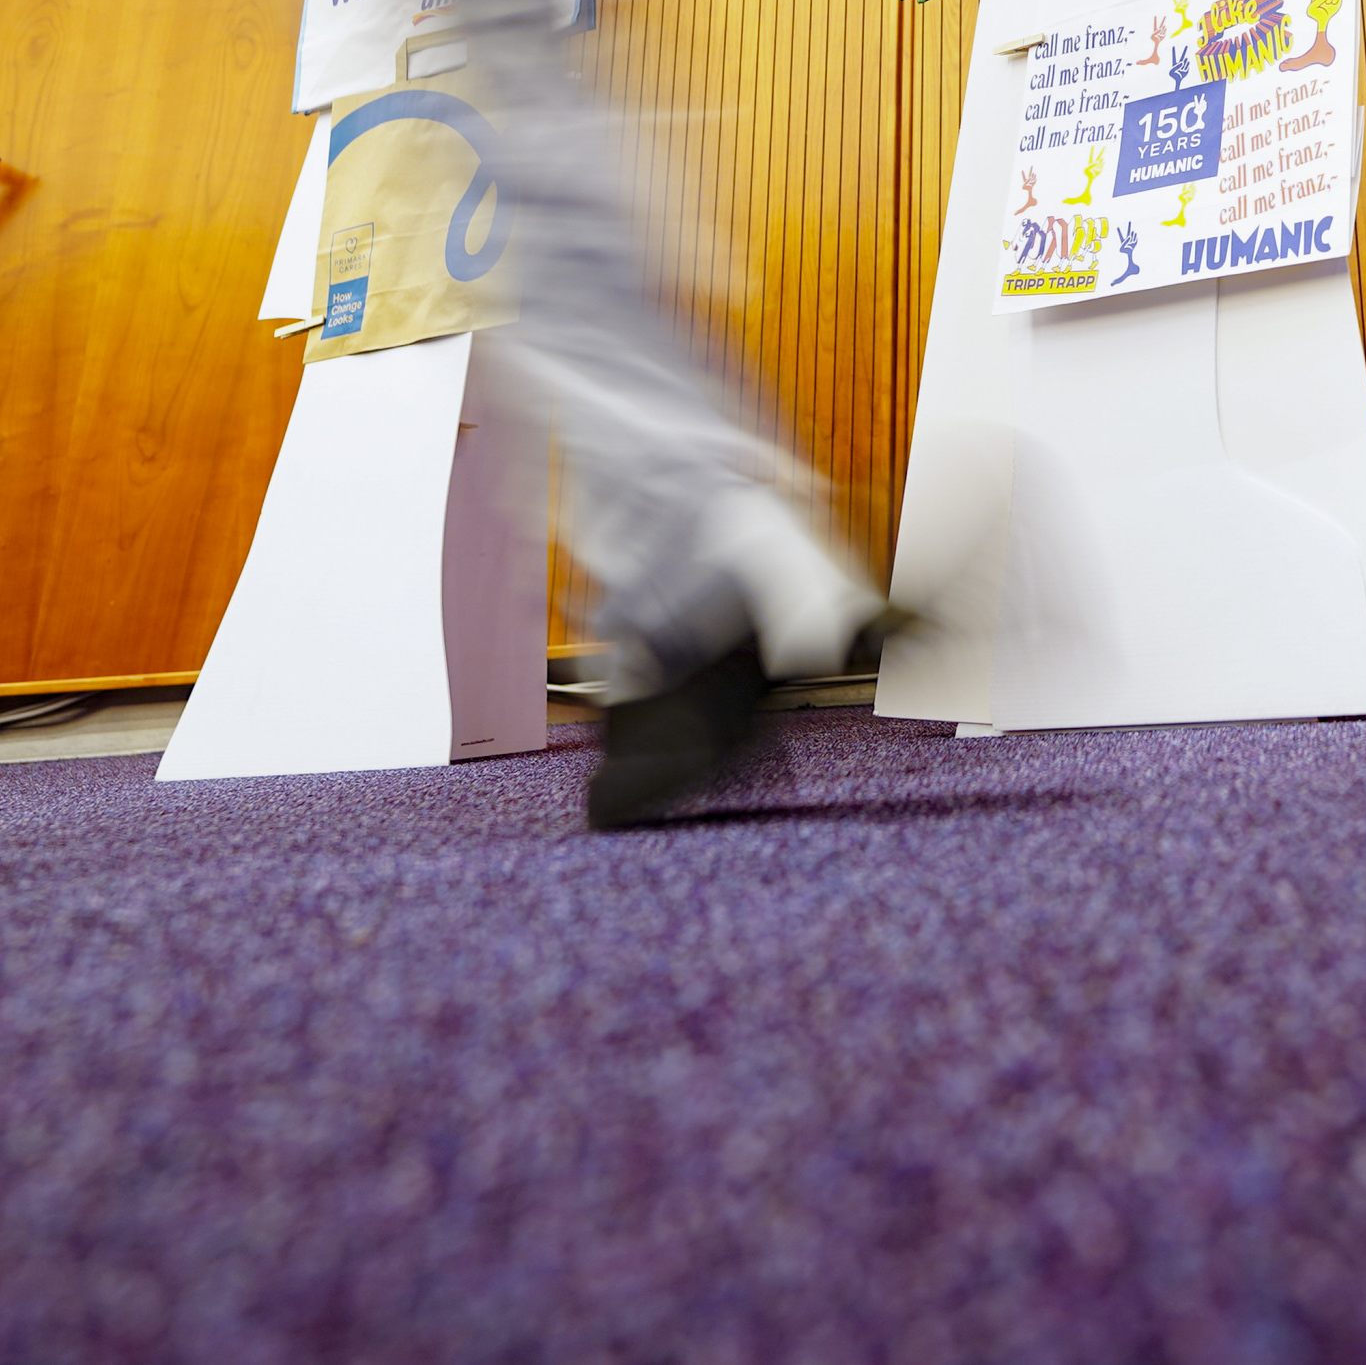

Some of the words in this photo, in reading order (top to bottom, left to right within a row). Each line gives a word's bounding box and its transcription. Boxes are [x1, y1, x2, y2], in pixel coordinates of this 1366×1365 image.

[1035, 32, 1058, 60] call
[1062, 34, 1081, 55] me
[1196, 14, 1293, 83] HUMANIC
[1030, 64, 1055, 90] call
[1059, 67, 1079, 86] me
[1025, 95, 1051, 121] call
[1054, 98, 1074, 117] me
[1138, 93, 1207, 143] 150
[1222, 102, 1244, 133] call
[1250, 98, 1270, 121] me
[1020, 126, 1045, 152] call
[1048, 129, 1069, 147] me
[1138, 133, 1201, 159] YEARS
[1220, 132, 1245, 164] call
[1251, 129, 1272, 152] me
[1130, 155, 1203, 183] HUMANIC
[1219, 164, 1247, 194] call
[1253, 161, 1273, 183] me
[1219, 194, 1247, 225] call
[1254, 191, 1275, 215] me
[1181, 216, 1333, 275] HUMANIC
[333, 291, 352, 304] How
[1006, 278, 1045, 291] TRIPP
[1049, 276, 1095, 289] TRAPP
[328, 314, 353, 327] Looks
[331, 300, 362, 316] Change
